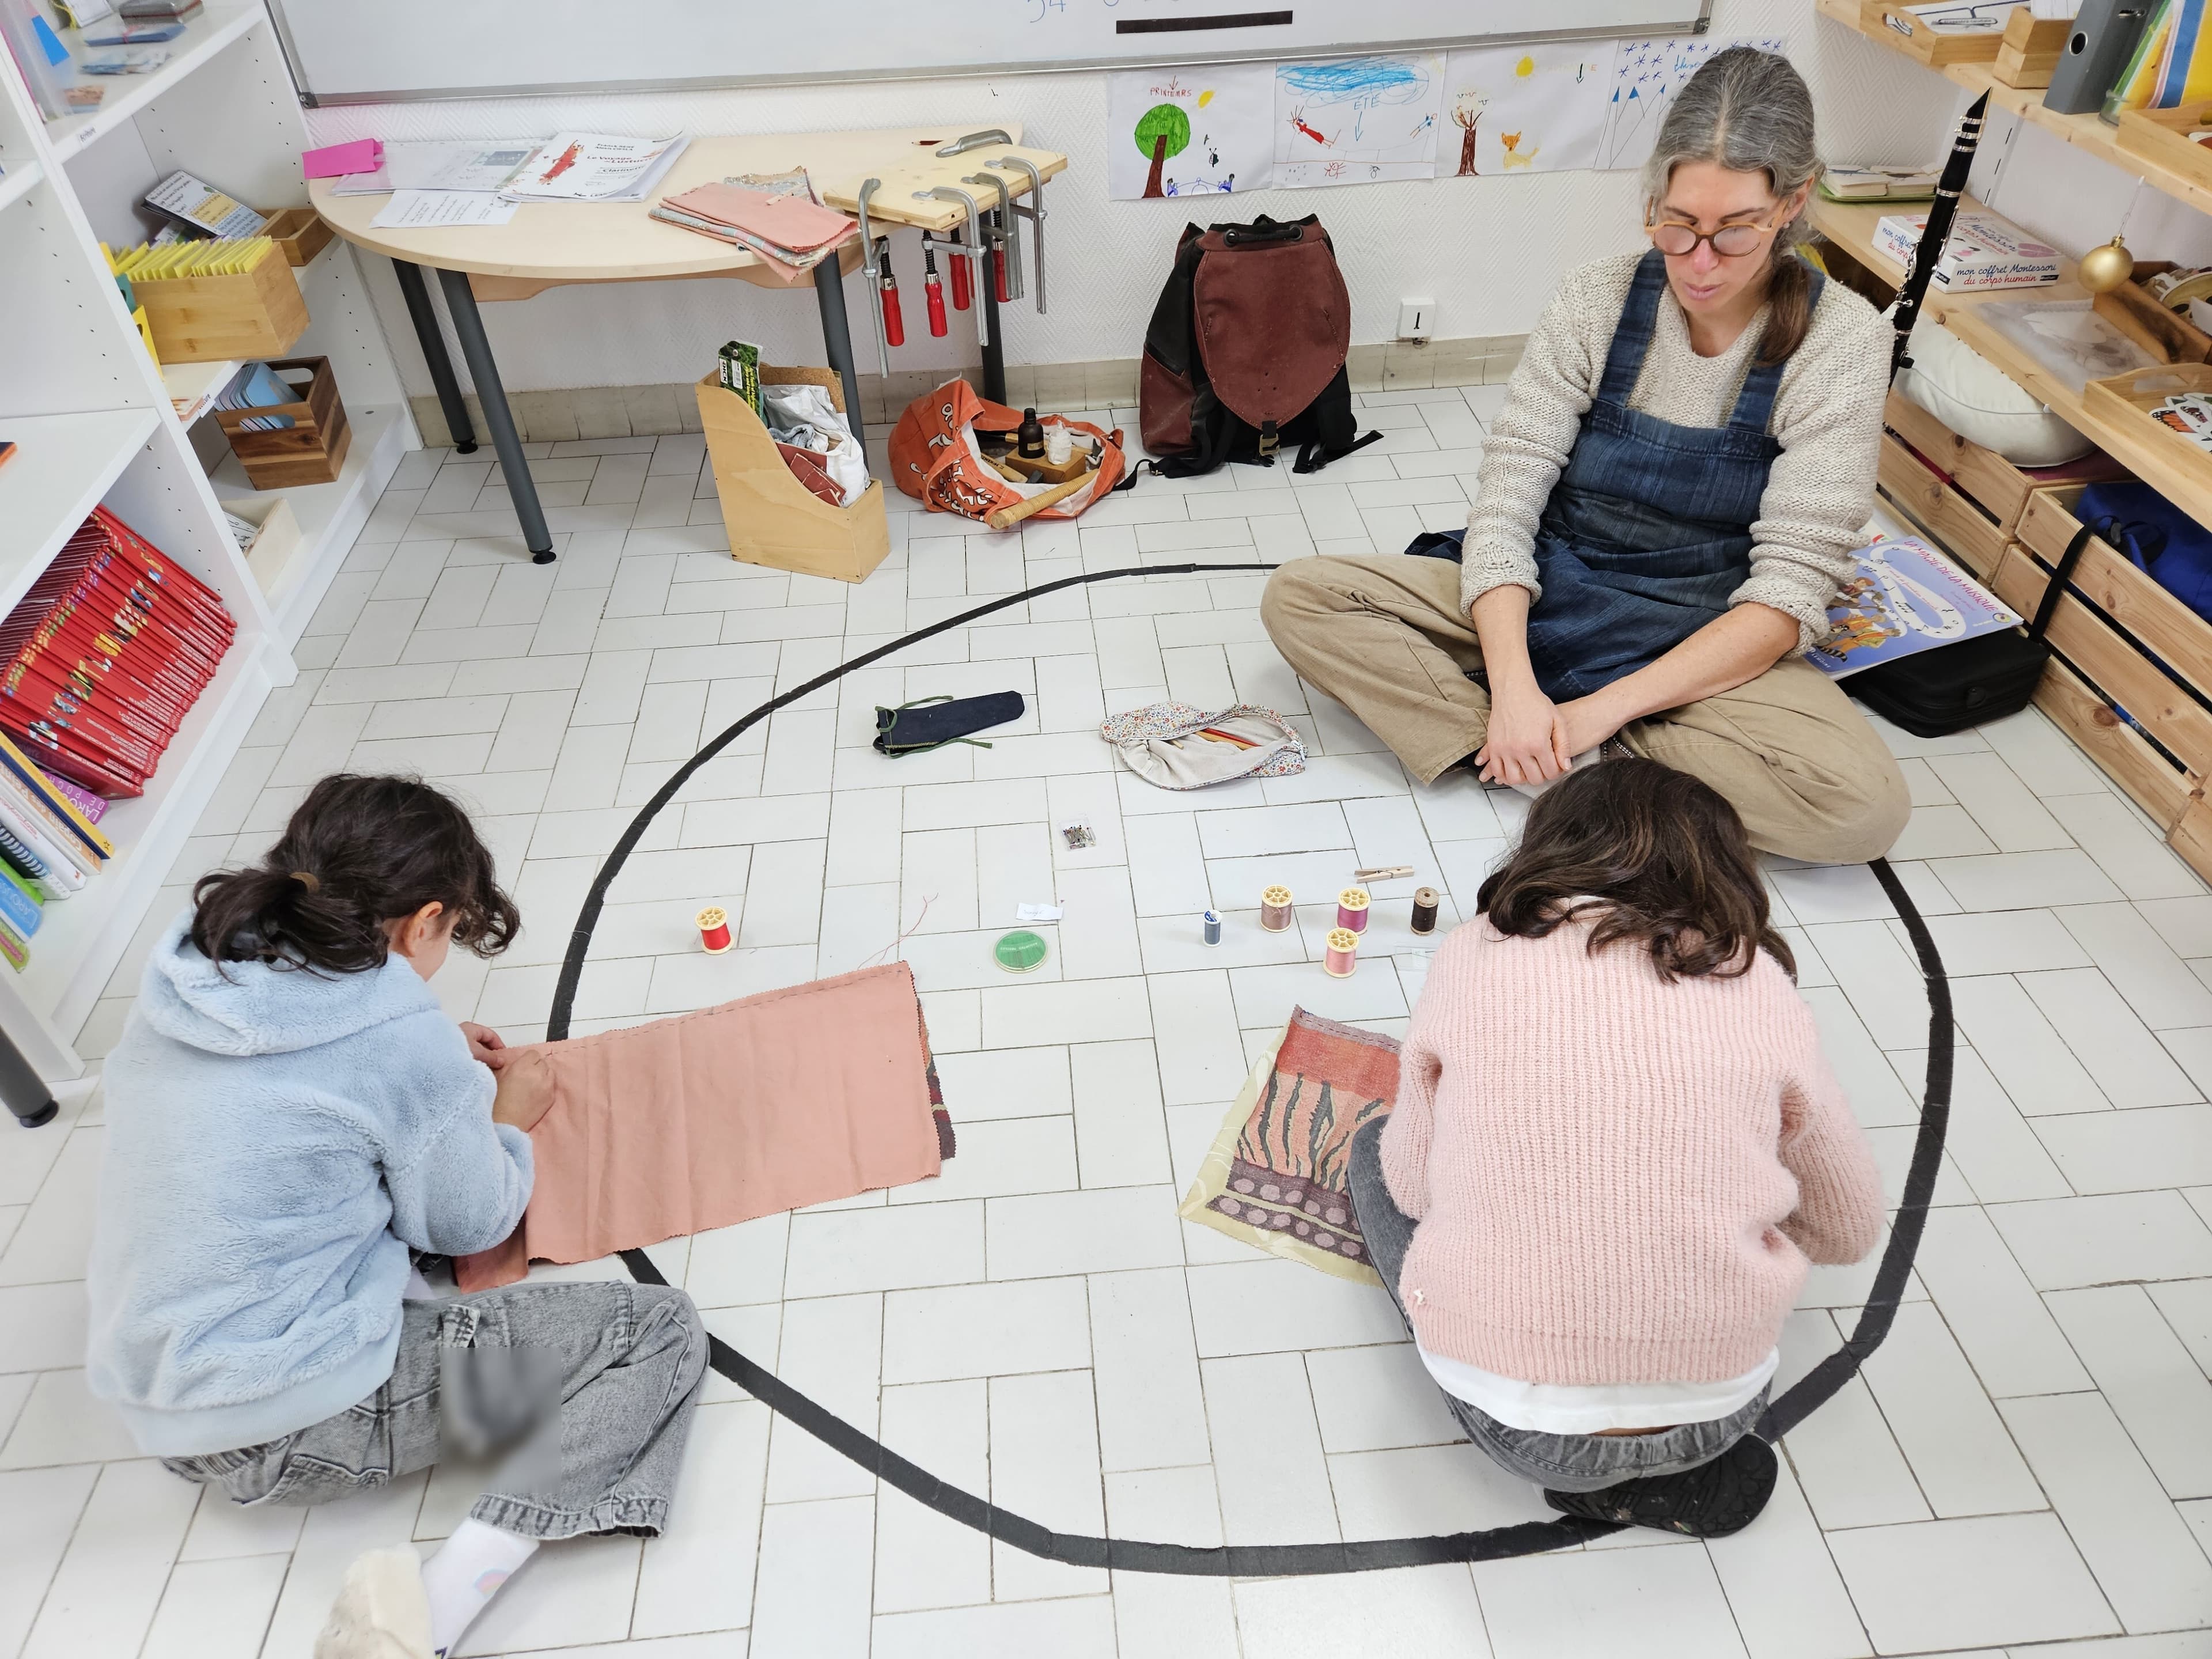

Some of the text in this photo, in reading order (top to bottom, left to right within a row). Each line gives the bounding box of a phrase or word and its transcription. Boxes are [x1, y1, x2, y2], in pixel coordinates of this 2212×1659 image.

[1896, 248, 1910, 262] corp
[1978, 264, 2007, 278] coffret
[2009, 263, 2057, 274] Montessori
[1963, 274, 2037, 287] du corps humain
[1904, 540, 1918, 548] LA
[1914, 547, 1942, 567] MAGIE
[1937, 565, 1955, 576] DE
[1948, 574, 1964, 585] LA
[1959, 582, 1999, 612] MUSIQUE
[89, 797, 106, 810] DE
